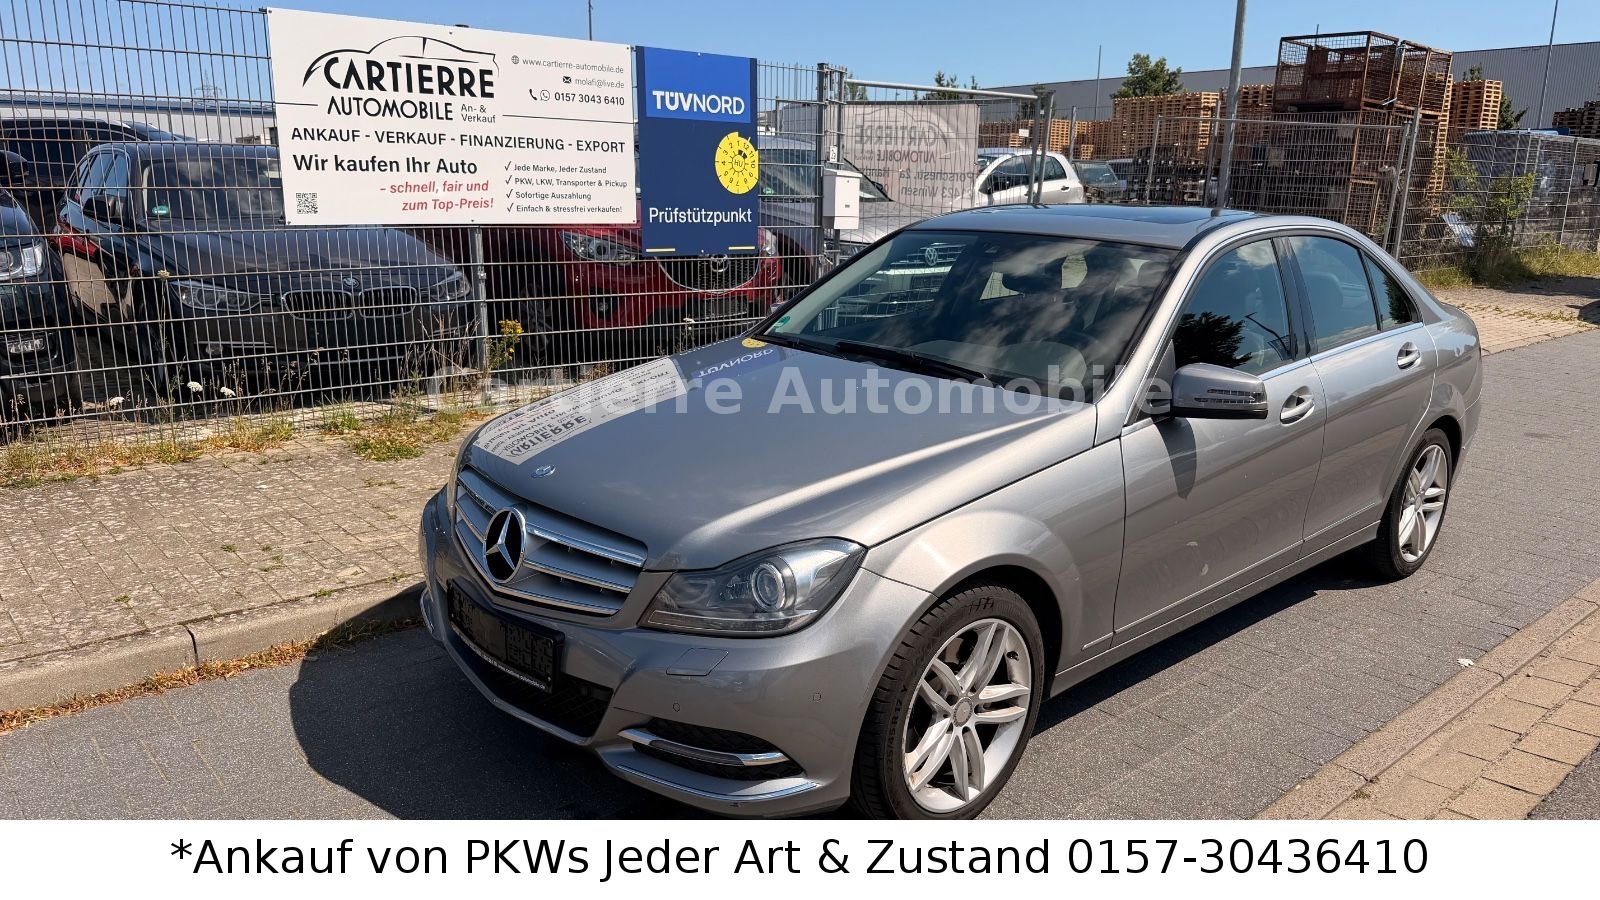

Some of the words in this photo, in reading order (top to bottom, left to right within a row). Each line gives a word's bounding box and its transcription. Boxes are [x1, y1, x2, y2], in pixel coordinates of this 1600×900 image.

[522, 58, 624, 73] www.cartierre-automobile.de
[323, 57, 495, 99] CARTIERRE
[574, 77, 624, 88] molafi@live.de
[554, 92, 576, 102] 0157
[578, 94, 602, 104] 3043
[604, 96, 625, 106] 6410
[327, 96, 454, 121] AUTOMOBILE
[460, 103, 477, 113] An-
[479, 104, 487, 113] &
[461, 113, 496, 124] Verkauf
[291, 127, 361, 143] ANKAUF
[375, 130, 447, 145] VERKAUF
[460, 134, 565, 150] FINANZIERUNG
[576, 140, 626, 153] EXPORT
[292, 154, 329, 171] Wir
[334, 154, 400, 173] kaufen
[406, 157, 431, 173] Ihr
[436, 158, 478, 174] Auto
[514, 164, 531, 172] Jede
[532, 164, 558, 173] Marke,
[559, 165, 577, 173] Jeder
[579, 166, 607, 174] Zustand
[389, 181, 439, 194] schnell,
[442, 180, 464, 192] fair
[466, 180, 489, 192] und
[514, 177, 534, 186] PKW,
[536, 178, 554, 187] LKW,
[556, 178, 596, 188] Transporter
[597, 179, 603, 187] &
[605, 180, 628, 188] Pickup
[515, 191, 550, 200] Sofortige
[550, 192, 592, 201] Auszahlung
[401, 200, 428, 211] zum
[432, 197, 494, 212] Top-Preis!
[516, 204, 544, 213] Einfach
[553, 205, 586, 213] stressfrei
[649, 207, 753, 227] Prüfstützpunkt
